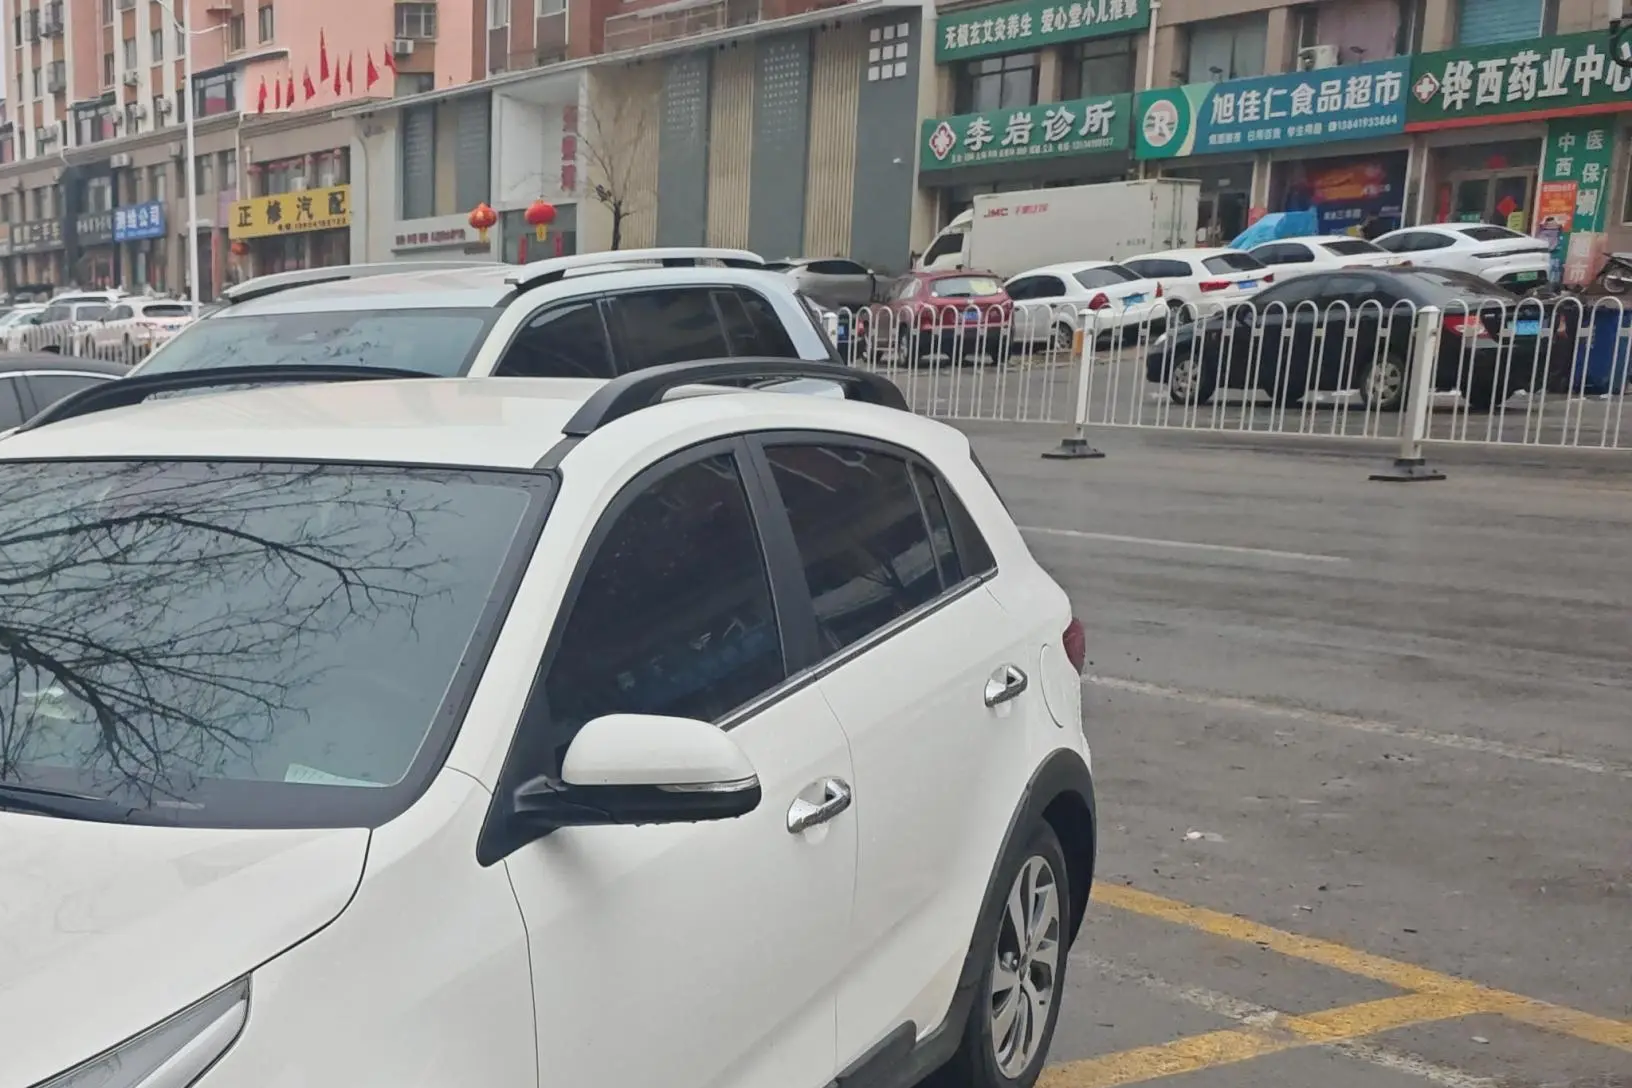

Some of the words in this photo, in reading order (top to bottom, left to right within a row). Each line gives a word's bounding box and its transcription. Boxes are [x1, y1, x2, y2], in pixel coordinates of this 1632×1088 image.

[1210, 71, 1402, 125] 旭佳仁食品超市
[964, 101, 1116, 151] 李岩诊所
